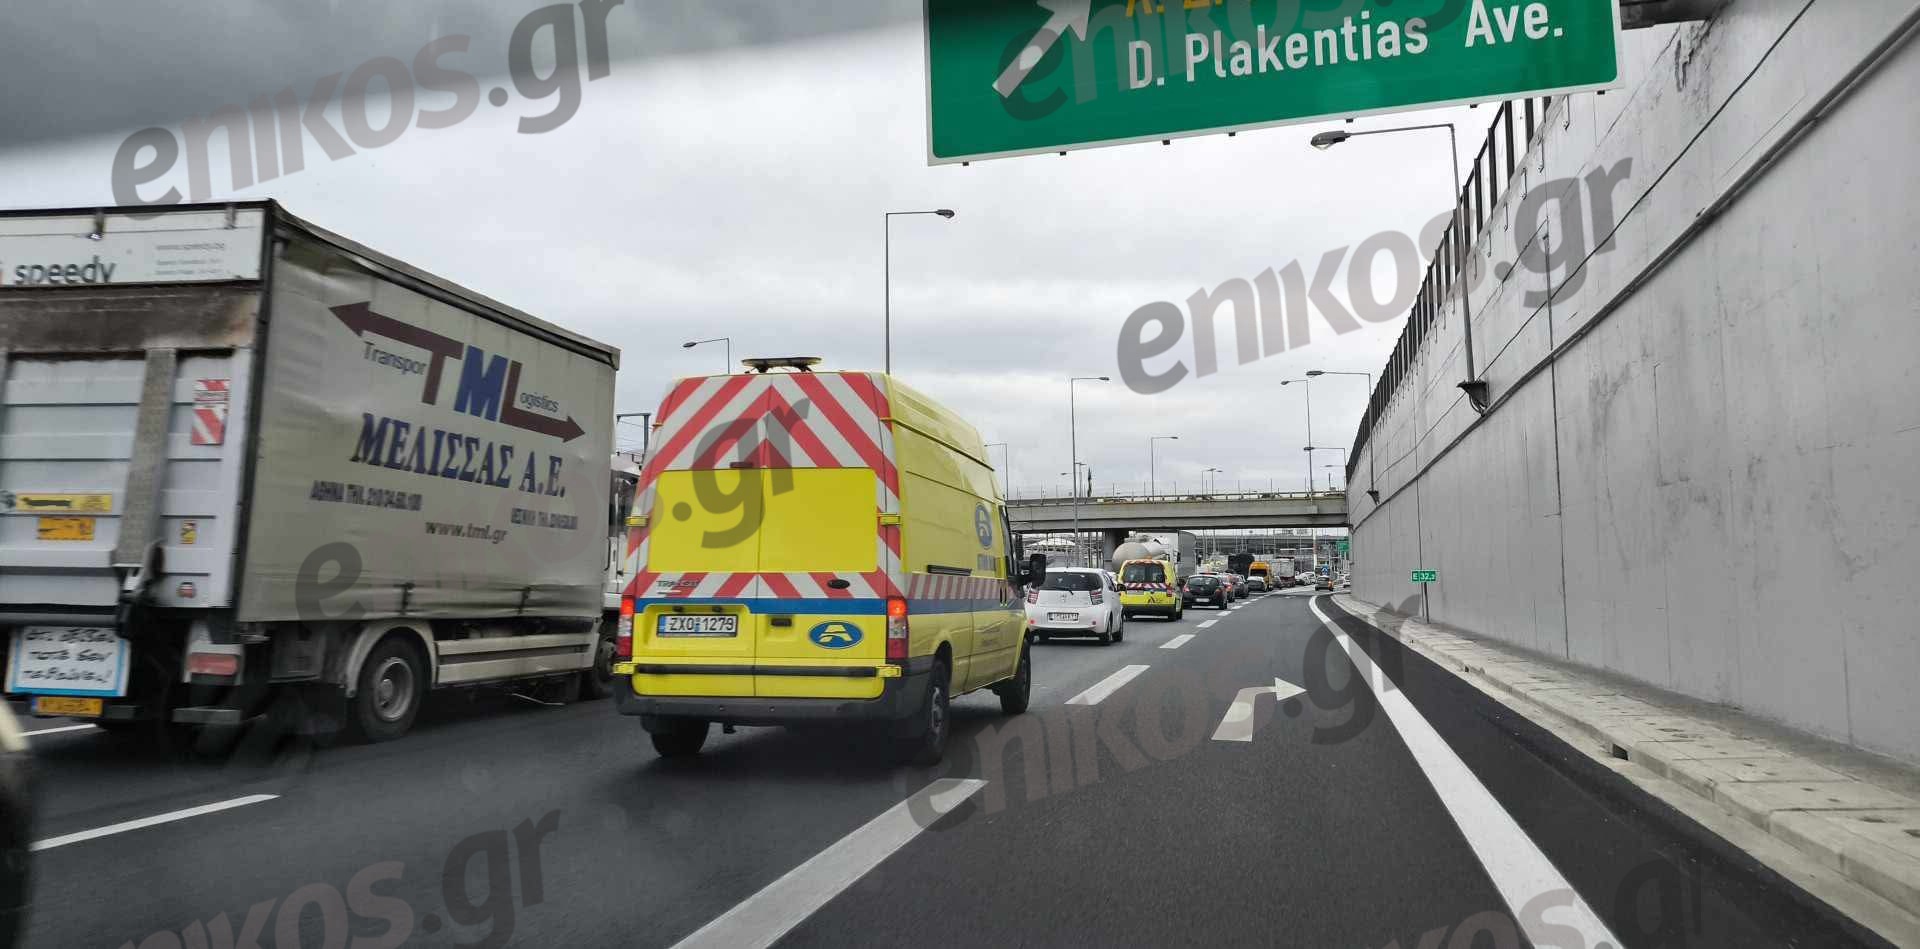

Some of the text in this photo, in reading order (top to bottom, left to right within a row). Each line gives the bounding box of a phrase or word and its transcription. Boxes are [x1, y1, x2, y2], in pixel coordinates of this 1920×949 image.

[1128, 0, 1563, 90] D. Plakentias Ave.
[15, 255, 116, 285] speedy
[350, 413, 566, 497] ΜΕΛΙΣΣΑΣ Α.Ε.
[425, 520, 507, 544] www.tml.gr
